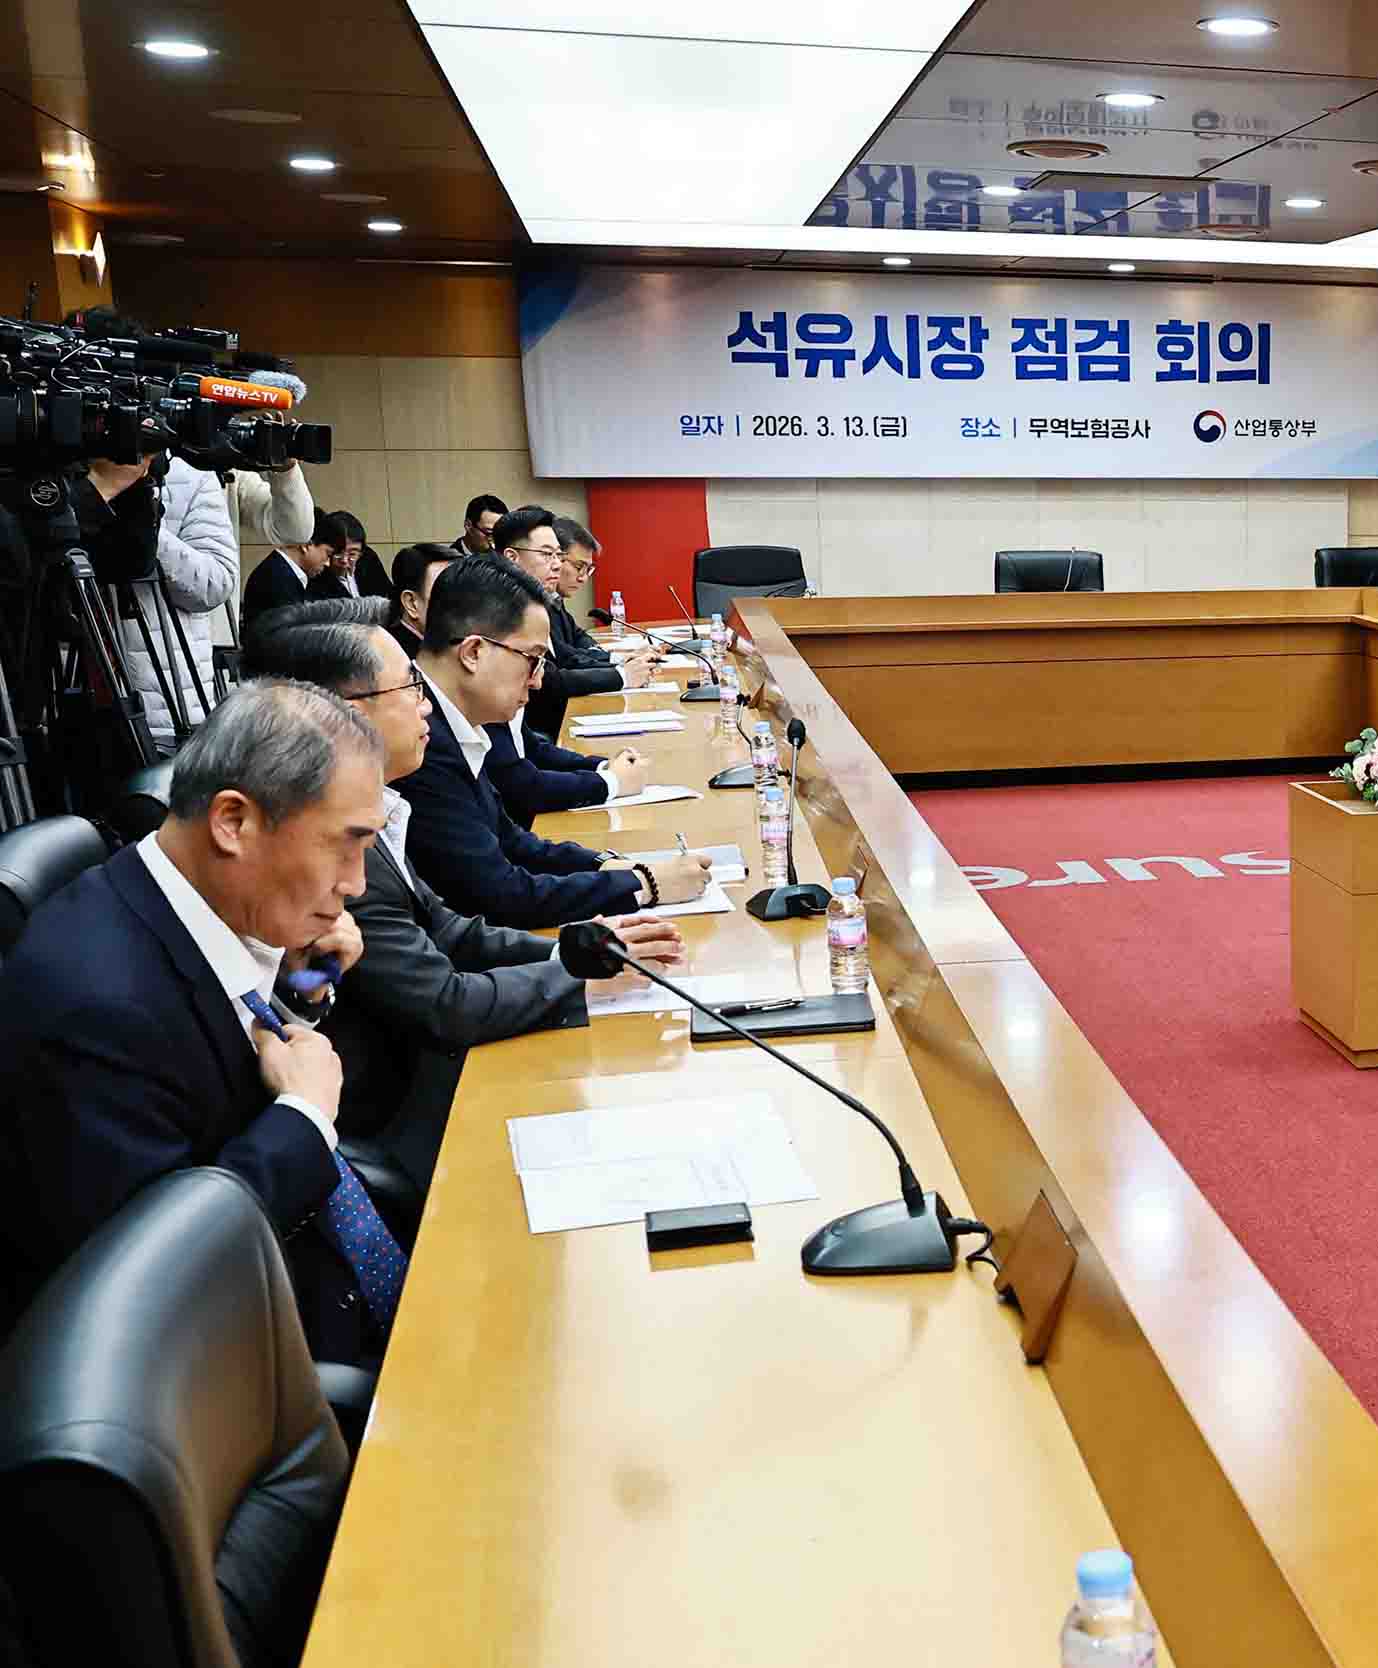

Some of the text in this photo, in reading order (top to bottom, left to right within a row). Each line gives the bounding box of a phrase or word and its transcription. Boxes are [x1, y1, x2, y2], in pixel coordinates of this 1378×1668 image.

[727, 311, 1271, 384] 석유시장 점검 회의
[211, 383, 279, 403] 연합뉴스TV
[679, 414, 724, 437] 일자
[752, 415, 808, 437] 2026.
[816, 415, 835, 437] 3.
[960, 417, 1151, 439] 장소 무역보험공사
[1234, 418, 1317, 438] 산업통상부
